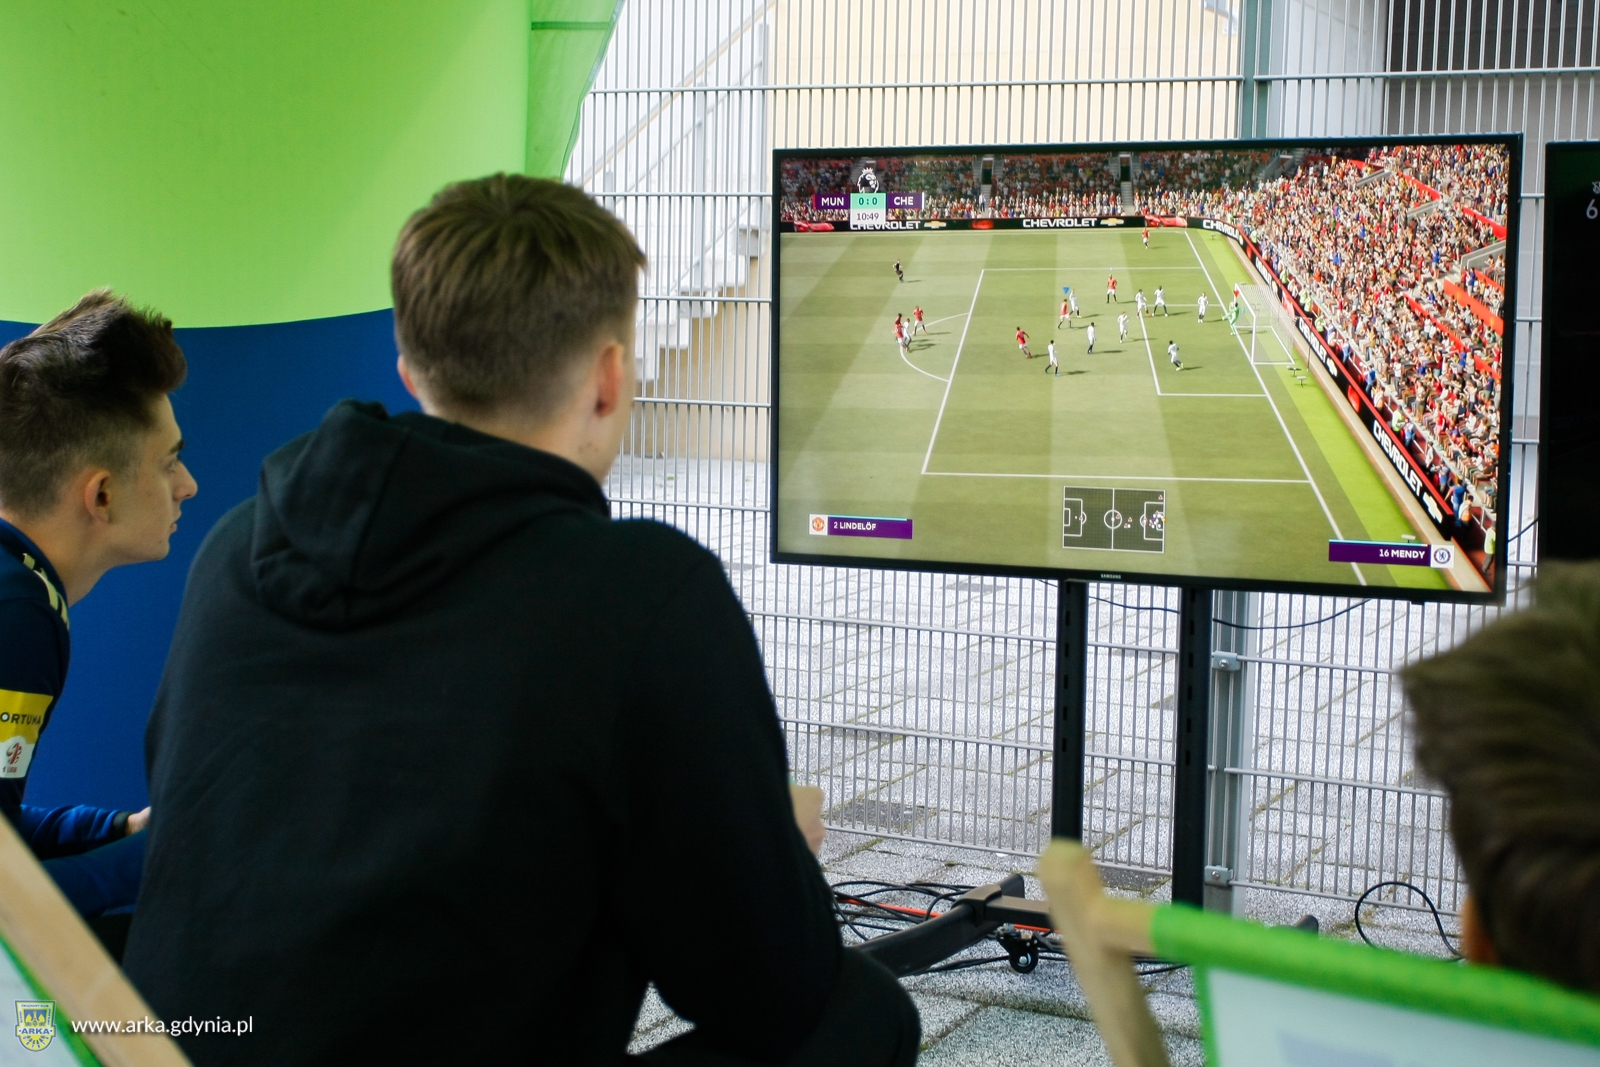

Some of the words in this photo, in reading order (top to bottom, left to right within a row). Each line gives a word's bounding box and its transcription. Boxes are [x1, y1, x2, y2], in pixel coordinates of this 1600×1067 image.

[821, 197, 845, 207] MUN
[893, 196, 914, 206] CHE
[856, 212, 879, 221] 10:49
[1022, 217, 1098, 228] CHEVROLET
[1373, 419, 1423, 497] CHEVROLET
[833, 521, 838, 529] 2
[839, 521, 877, 531] LINDELÖF
[1379, 548, 1390, 557] 16
[1391, 549, 1425, 559] MENDY
[0, 711, 42, 725] ORTUNA
